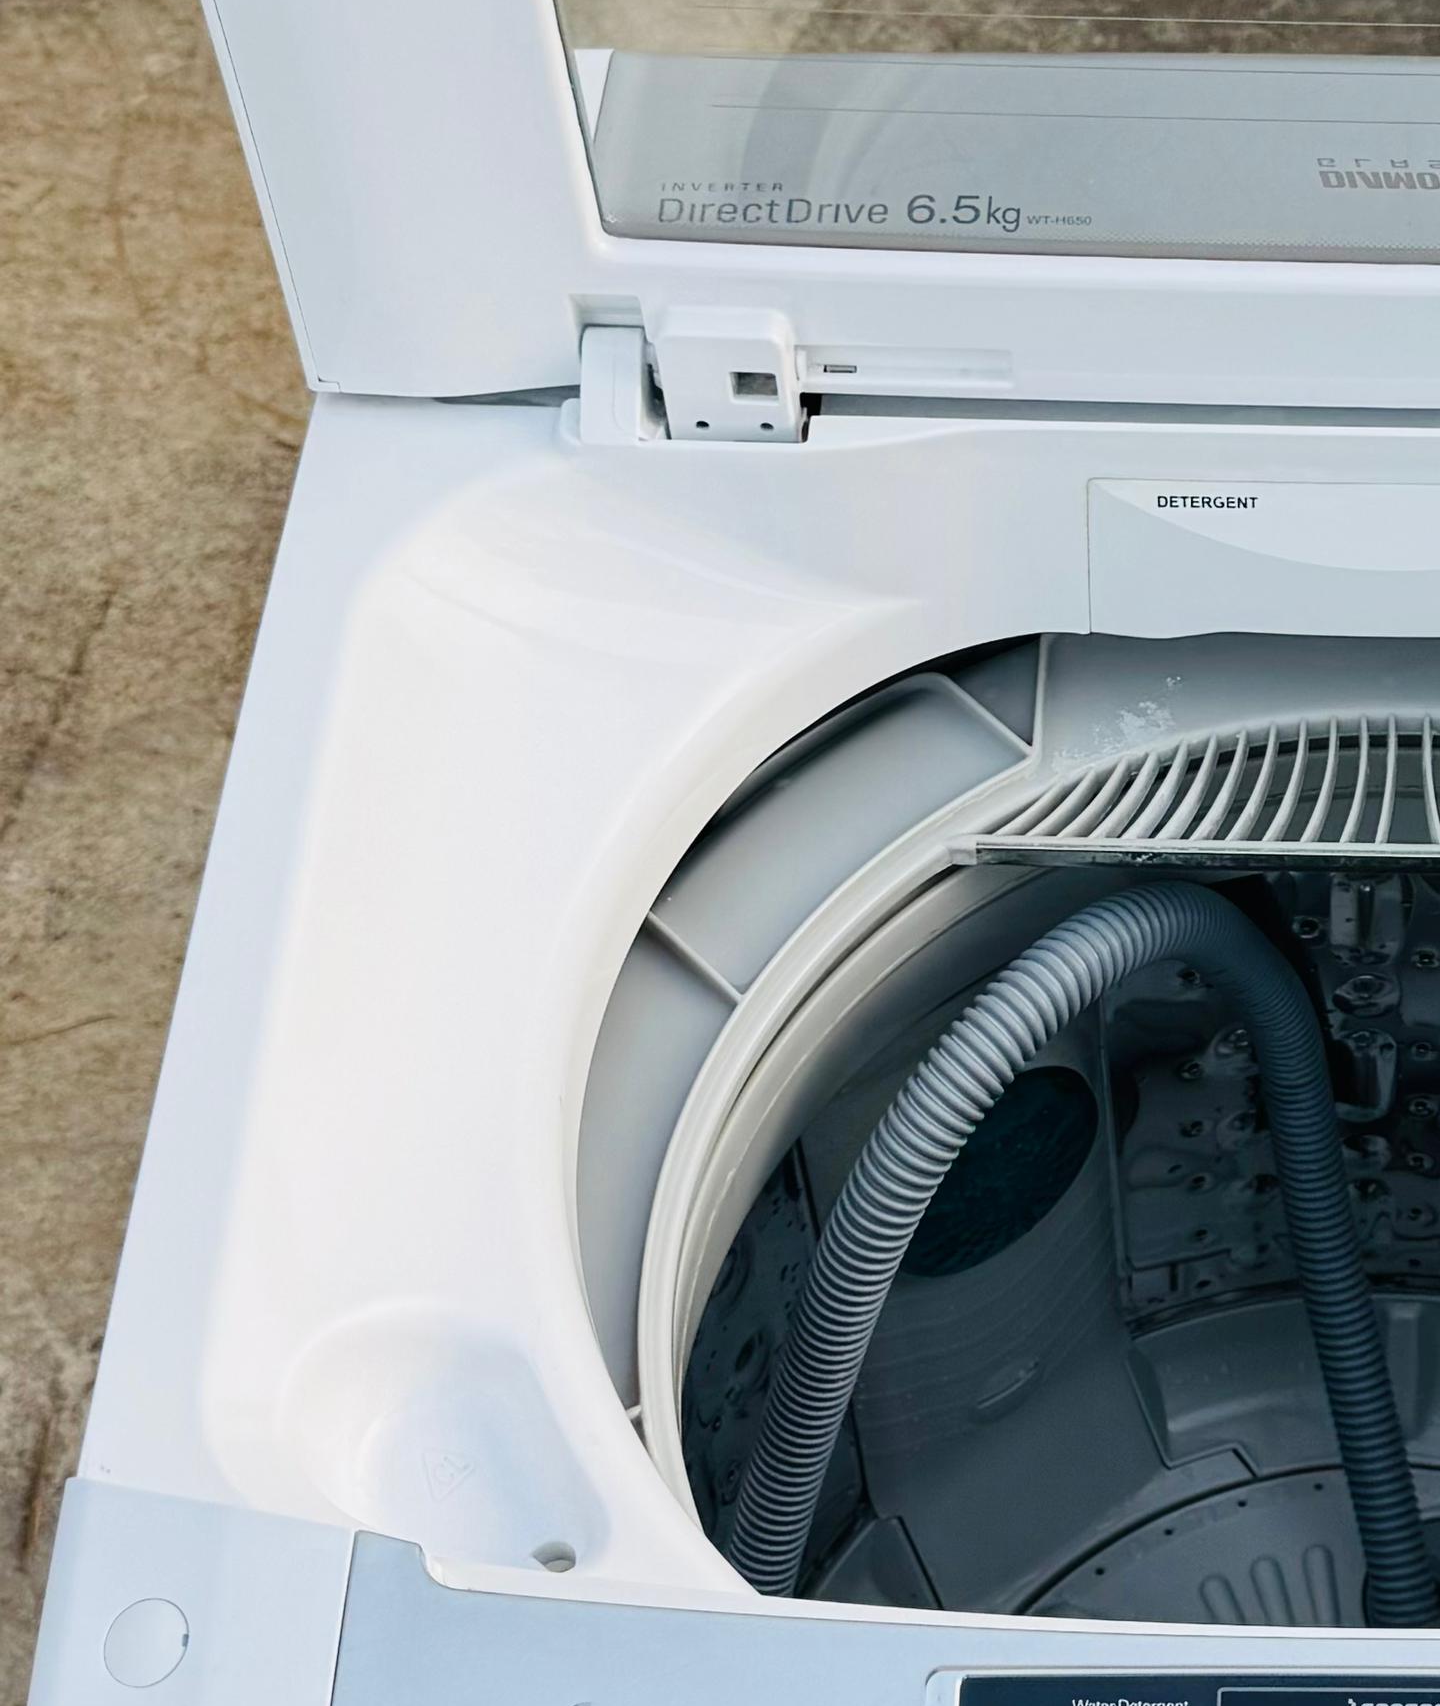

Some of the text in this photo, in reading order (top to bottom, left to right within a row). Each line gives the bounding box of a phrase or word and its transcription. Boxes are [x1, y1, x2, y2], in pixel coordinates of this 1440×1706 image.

[661, 182, 784, 192] INVERTER
[906, 194, 1021, 233] 6.5kg
[1157, 496, 1259, 510] DETERGENT
